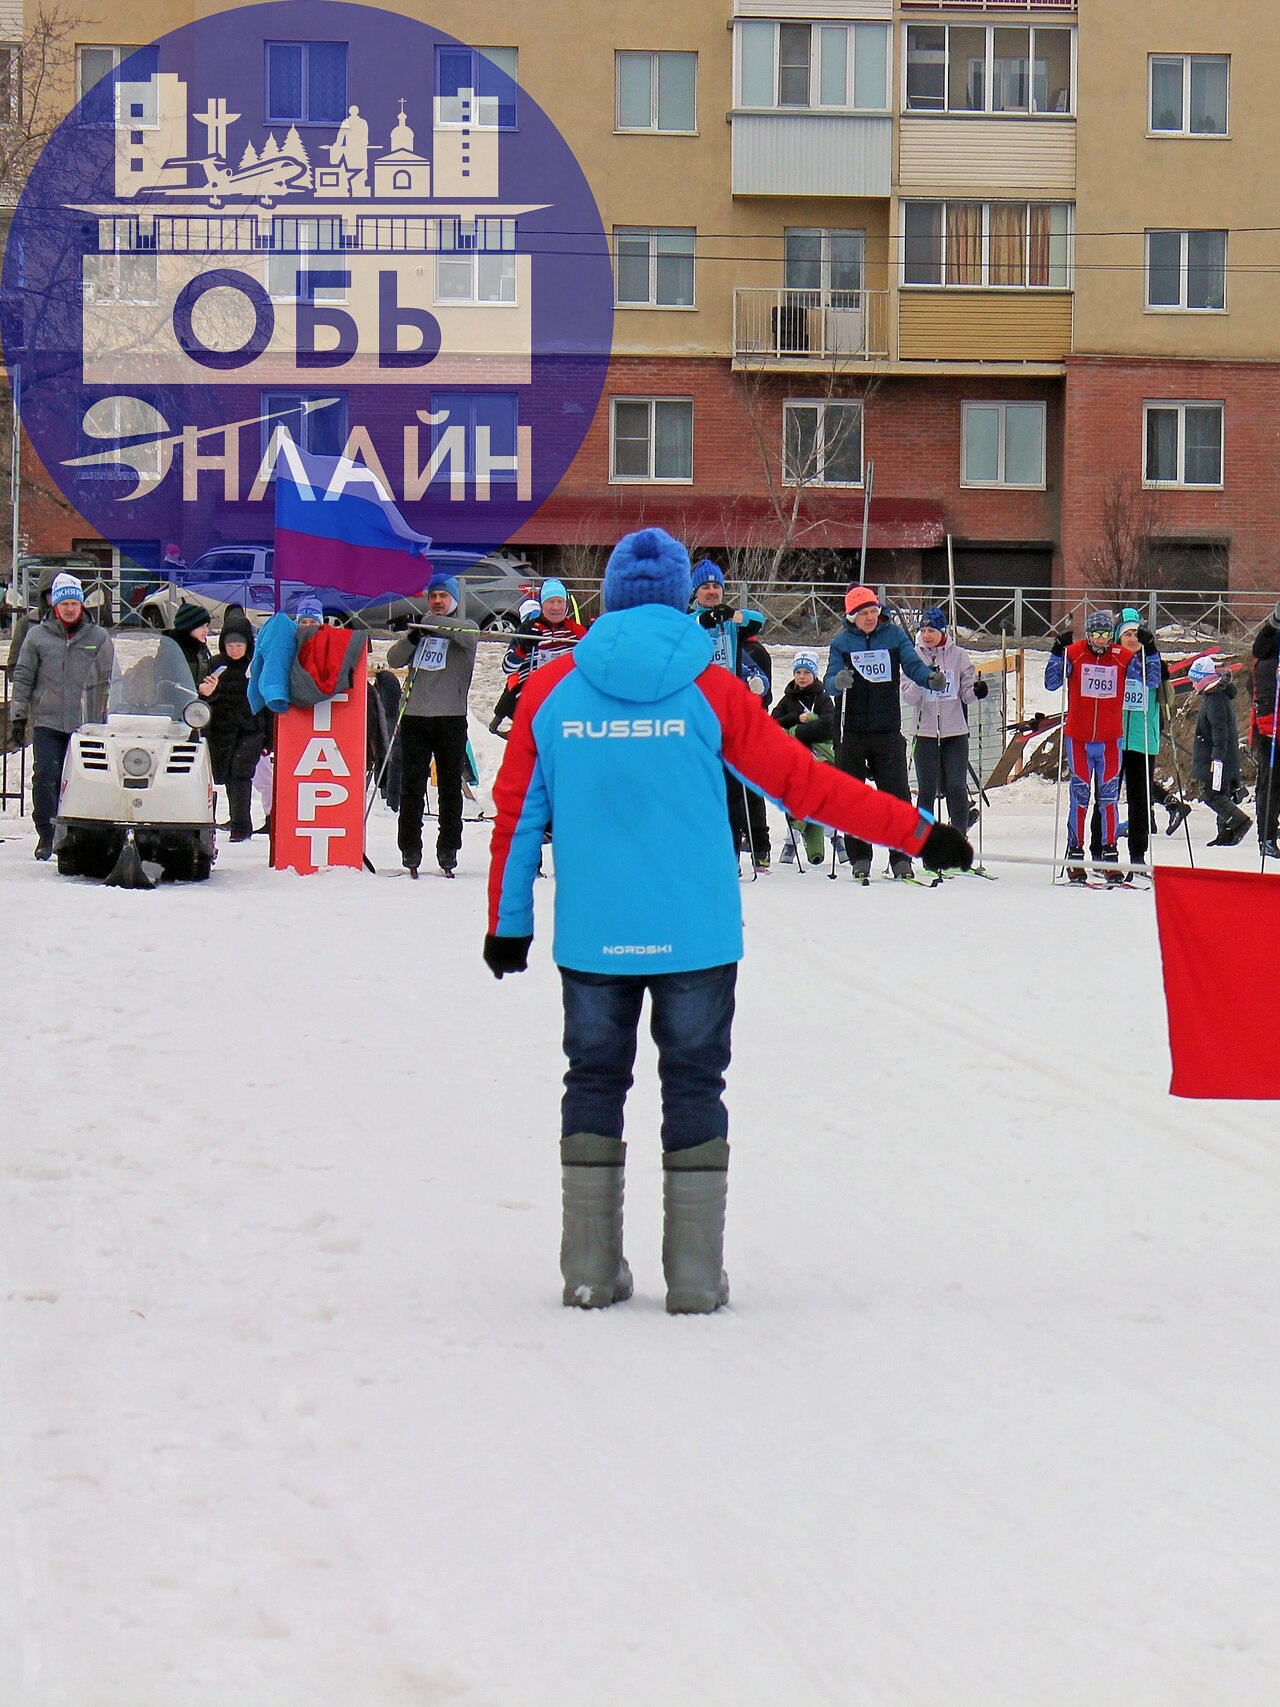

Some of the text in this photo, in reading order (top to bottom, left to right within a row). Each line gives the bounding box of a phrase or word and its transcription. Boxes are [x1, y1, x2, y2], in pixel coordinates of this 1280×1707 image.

[859, 662, 886, 676] 7960
[1088, 678, 1113, 691] 7963
[562, 719, 686, 738] RUSSIA
[602, 944, 673, 955] NORDSKI
